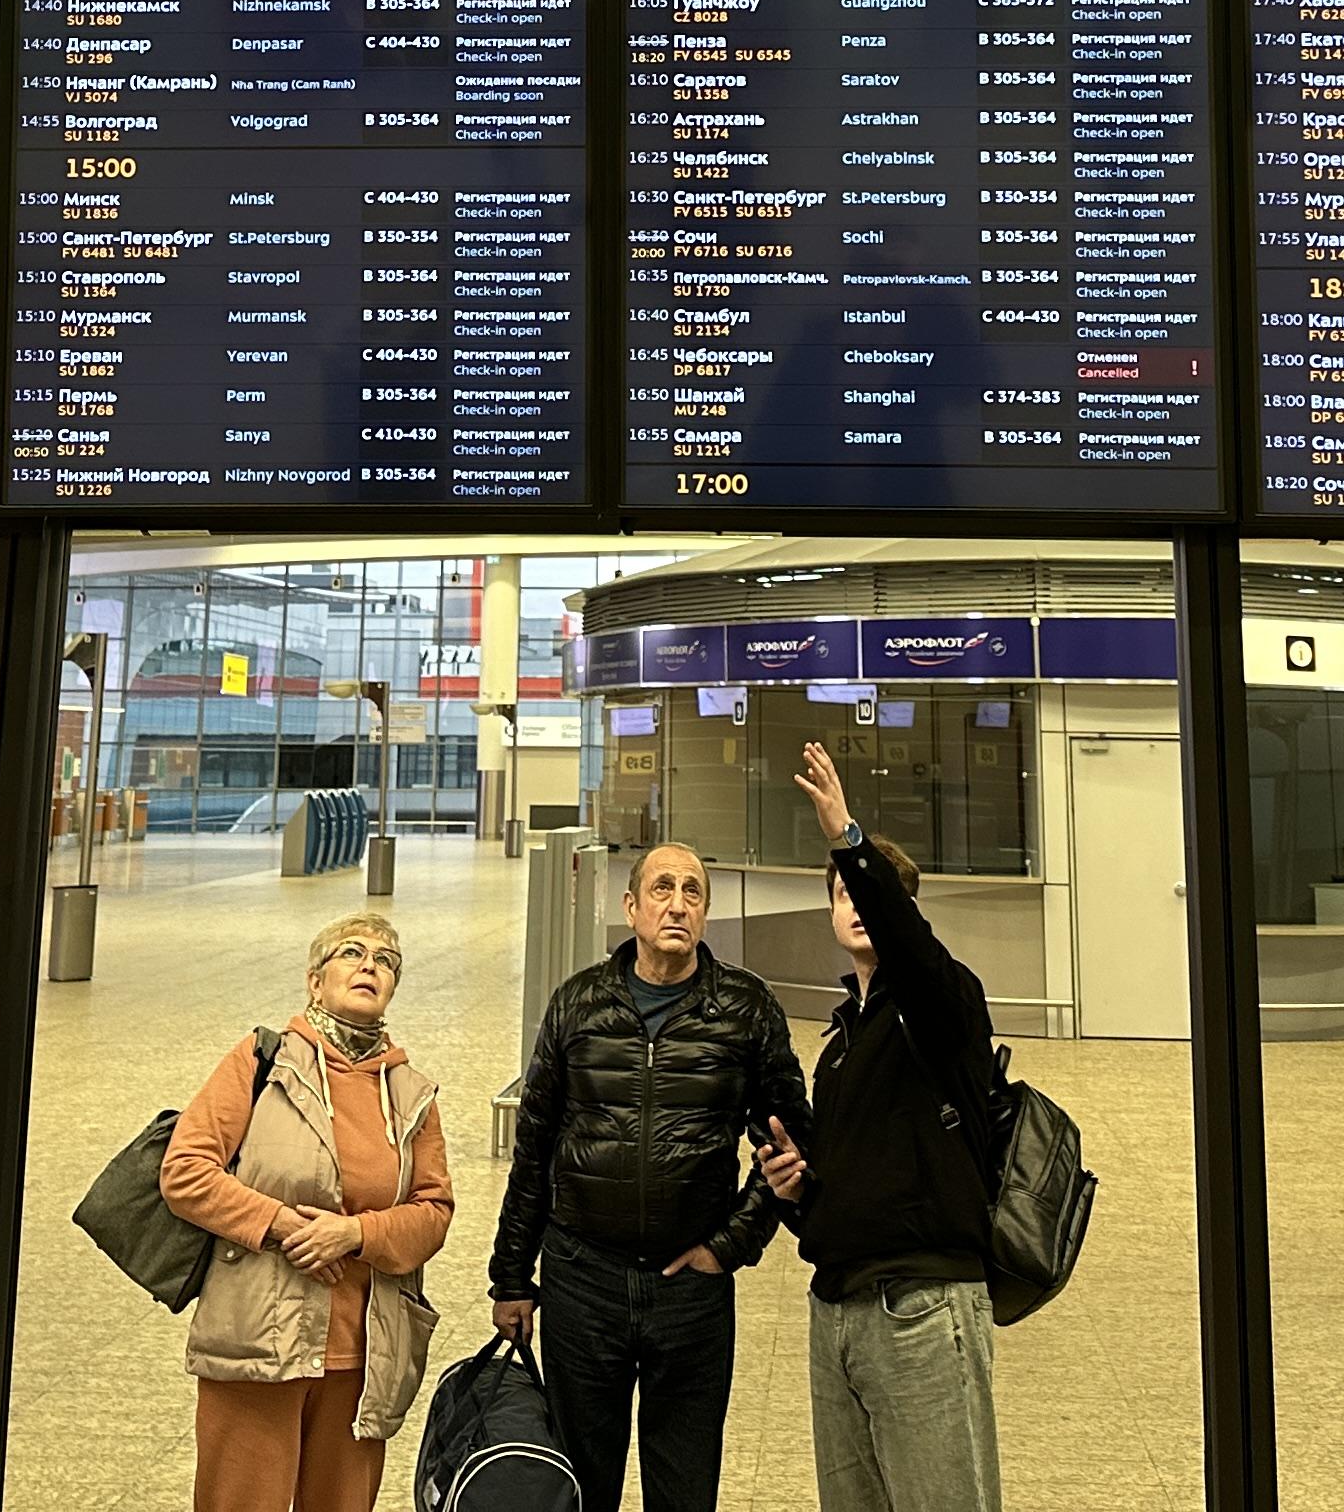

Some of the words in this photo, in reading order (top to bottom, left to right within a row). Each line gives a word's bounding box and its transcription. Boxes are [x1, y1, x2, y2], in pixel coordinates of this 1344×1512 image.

[233, 39, 303, 52] Denpasar
[674, 74, 746, 90] Саратов
[673, 89, 691, 100] SU
[696, 89, 729, 100] 1358
[231, 115, 307, 130] Volgograd
[68, 158, 136, 177] 15:00
[228, 271, 299, 286] Stavropol
[228, 310, 306, 322] Murmansk
[844, 390, 915, 406] Shanghai
[57, 468, 123, 482] Нижний
[129, 469, 210, 485] Новгород
[226, 469, 274, 484] Nizhny
[279, 469, 350, 484] Novgorod
[362, 468, 371, 479] B
[376, 468, 436, 480] 305-364
[453, 485, 505, 495] Check-in
[509, 487, 540, 497] open
[678, 474, 748, 494] 17:00
[747, 641, 798, 651] АЭРОФЛОТ
[885, 638, 964, 648] АЭРОФЛОТ
[860, 705, 871, 717] 10
